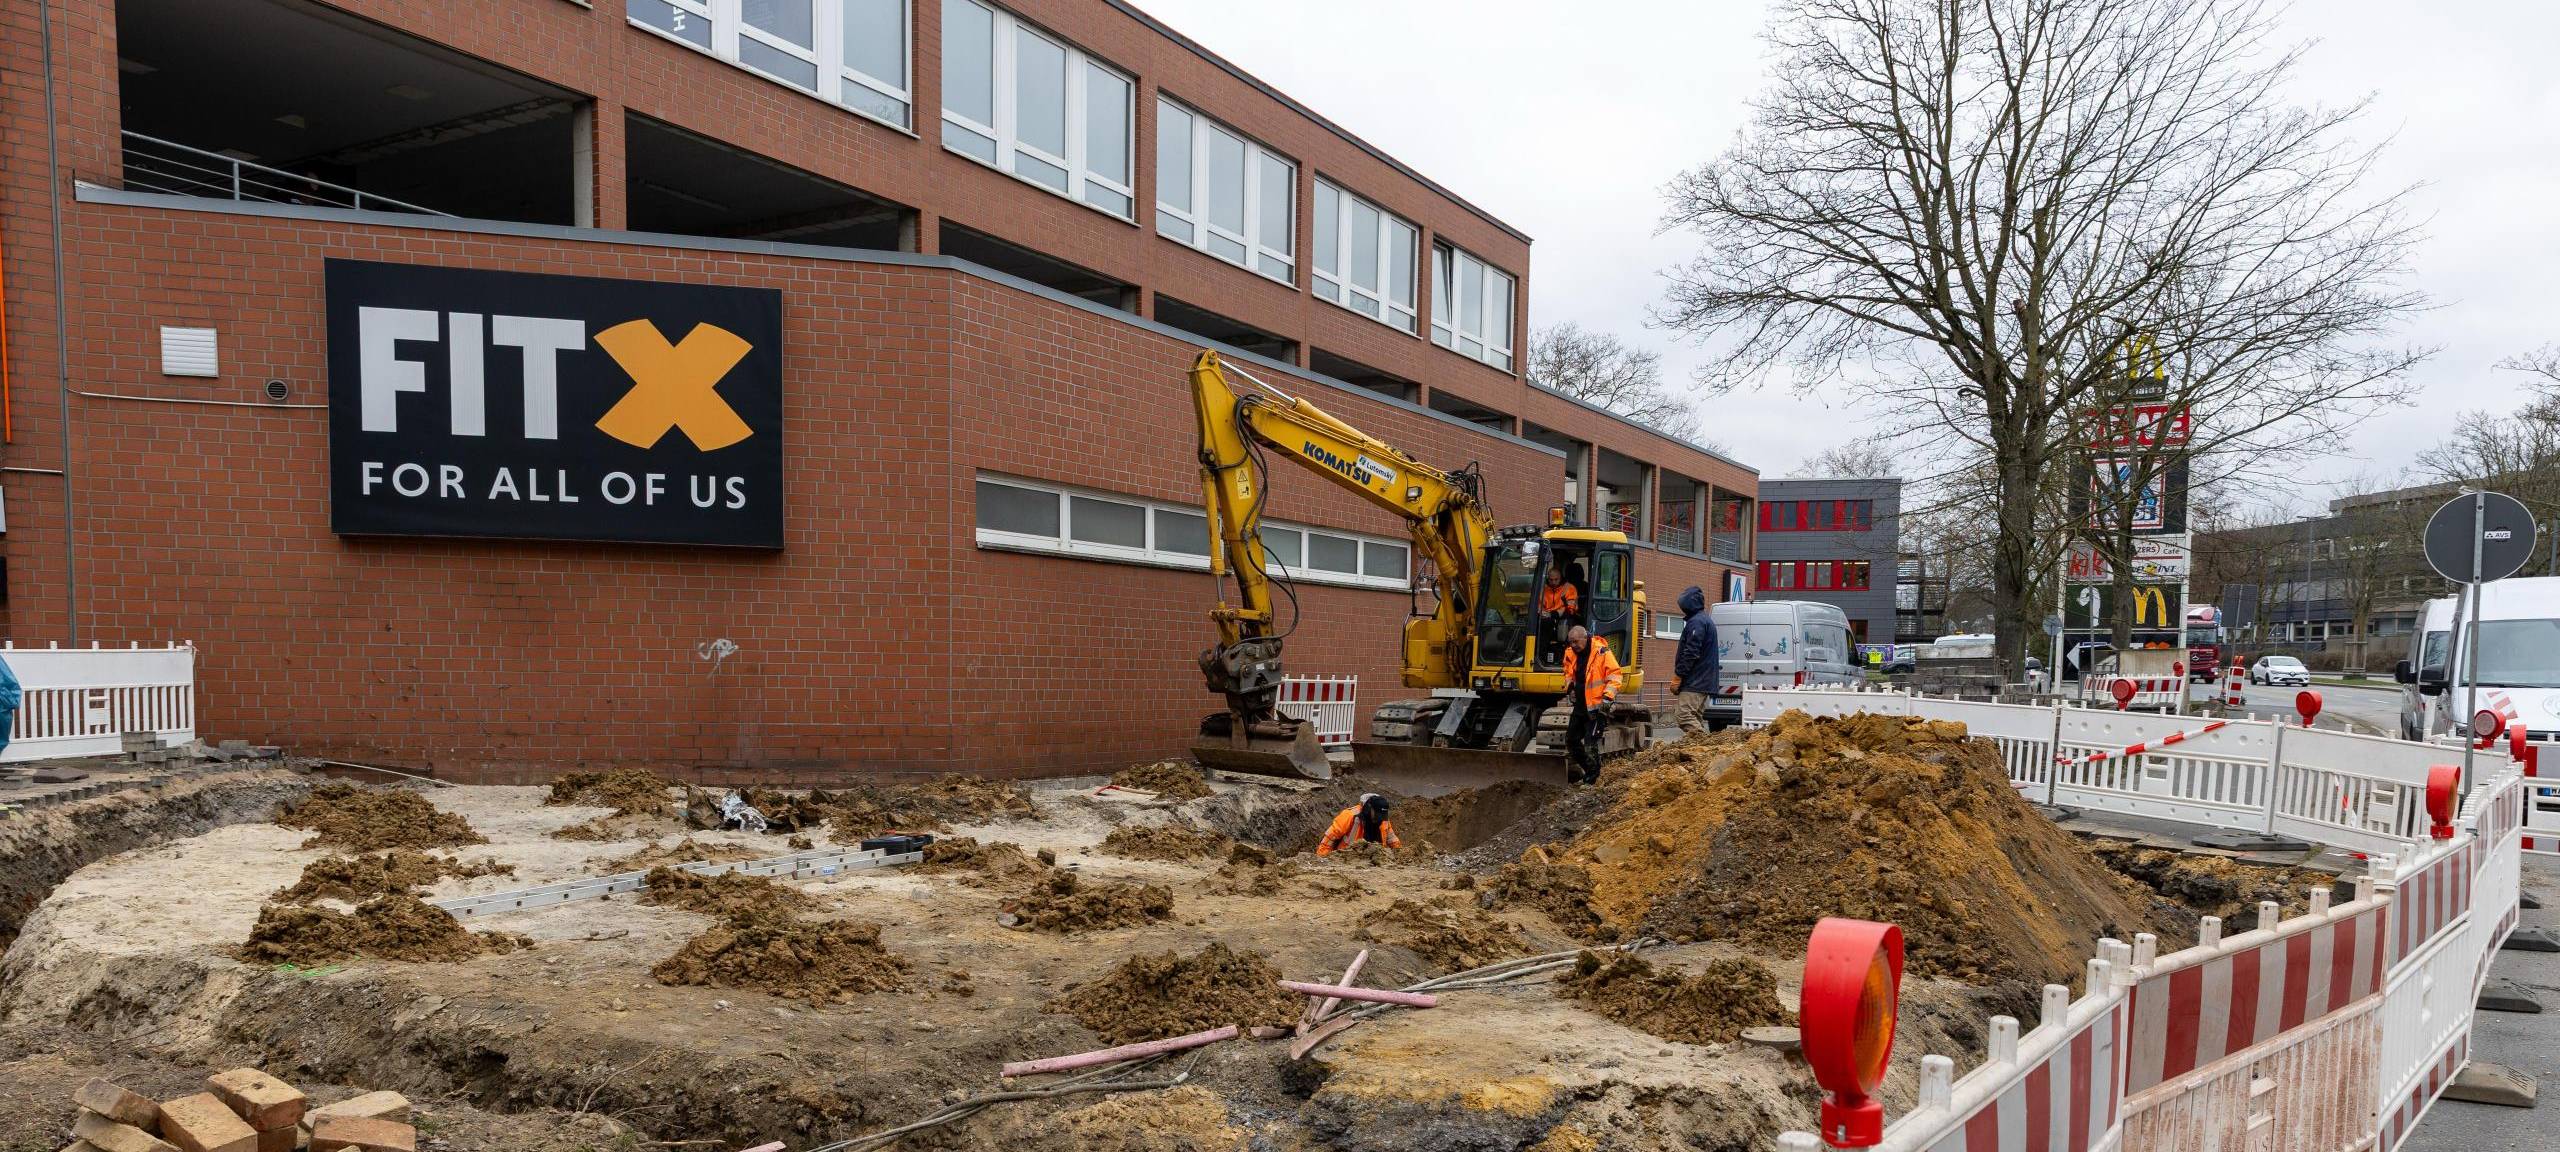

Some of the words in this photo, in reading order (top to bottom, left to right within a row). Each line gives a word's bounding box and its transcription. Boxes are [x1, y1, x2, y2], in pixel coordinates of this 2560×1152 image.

[359, 306, 754, 452] FITX
[362, 461, 466, 498] FOR
[488, 467, 579, 503] ALL
[601, 471, 666, 506] OF
[690, 475, 747, 510] US
[1303, 441, 1371, 485] KOMATSU
[1366, 462, 1394, 482] Lutomsky
